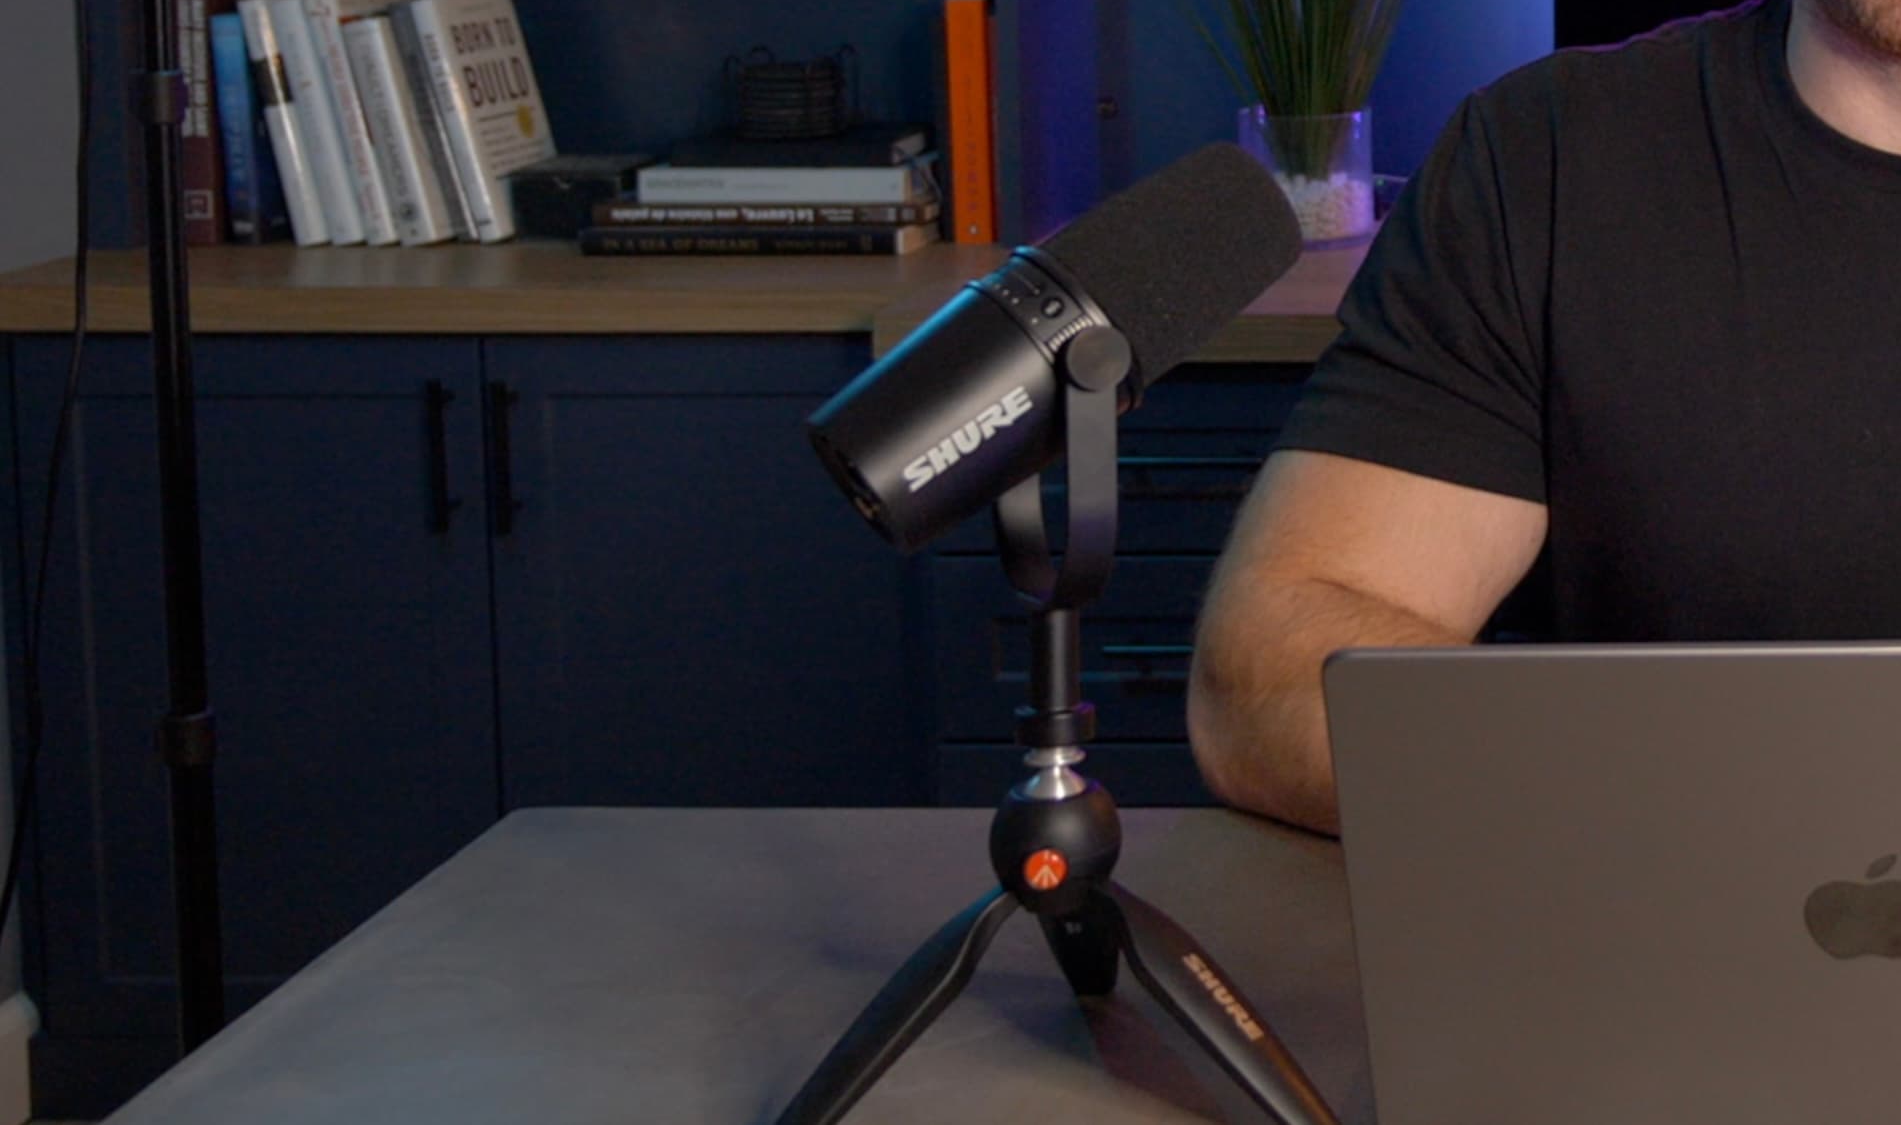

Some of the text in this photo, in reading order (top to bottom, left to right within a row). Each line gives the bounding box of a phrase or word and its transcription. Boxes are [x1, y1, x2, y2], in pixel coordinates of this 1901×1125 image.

[451, 16, 517, 55] BORN TO
[462, 55, 530, 108] BUILD
[902, 385, 1034, 494] SHURE
[1181, 952, 1265, 1042] SHURE
